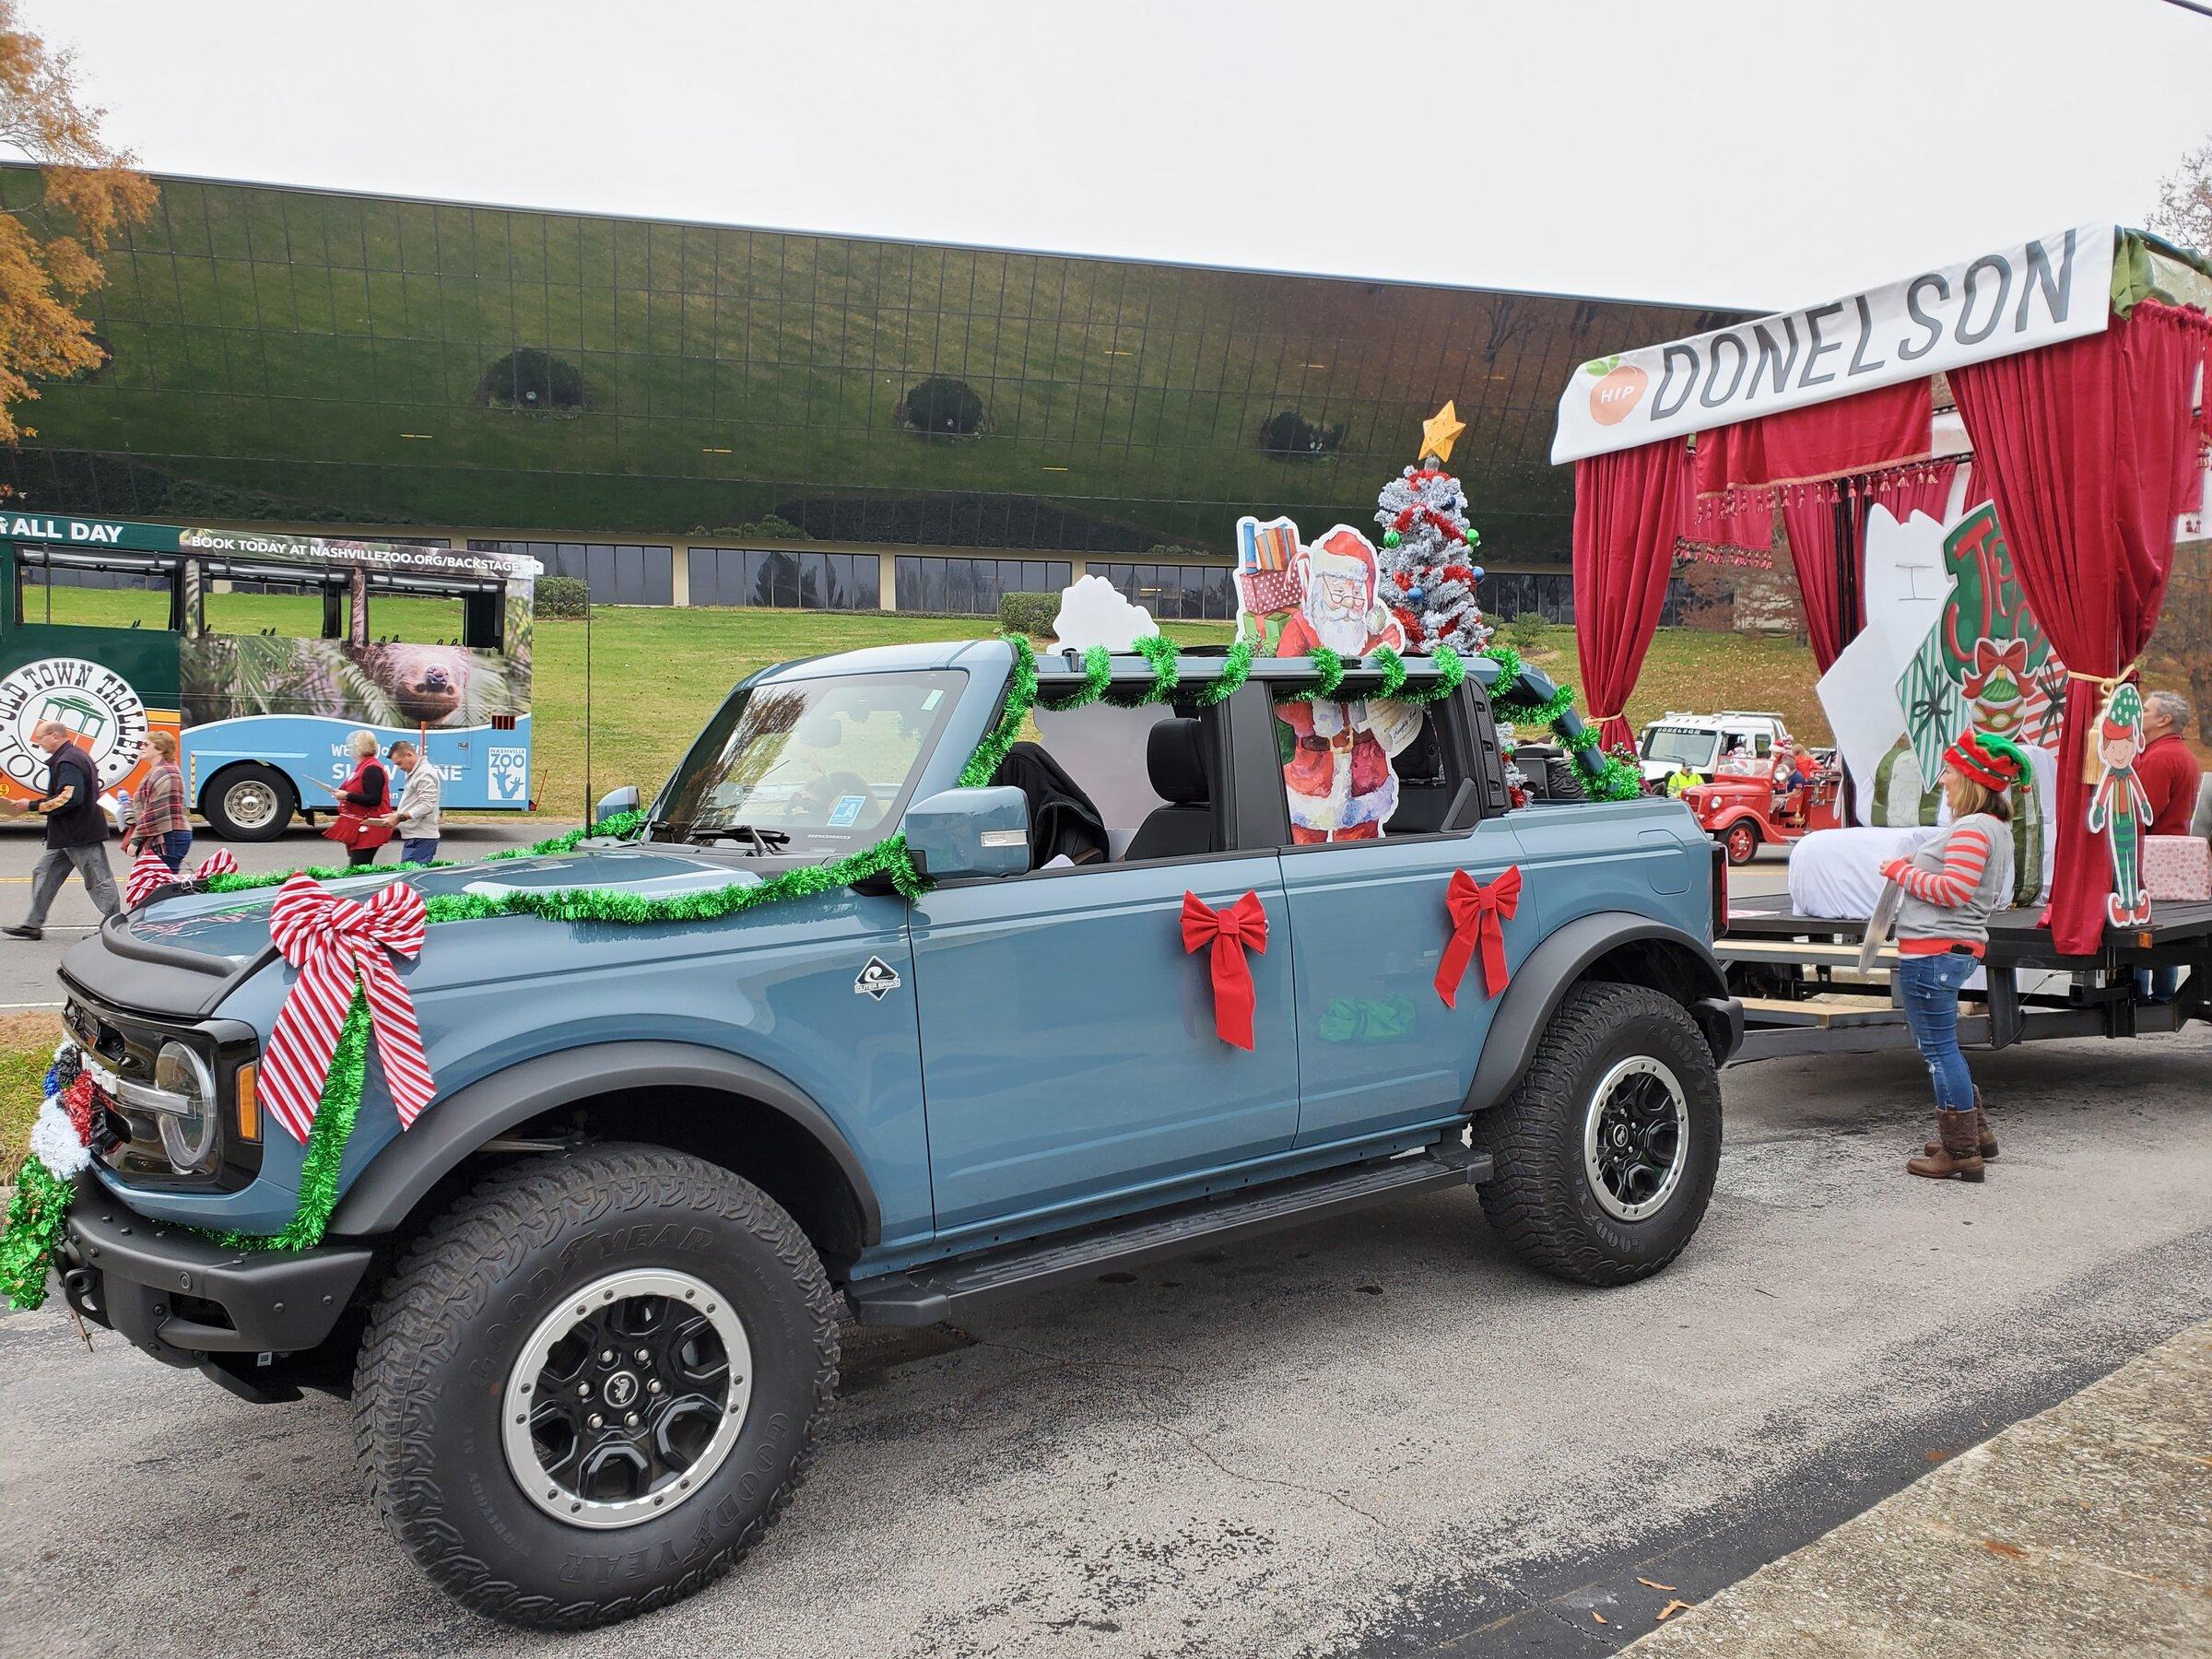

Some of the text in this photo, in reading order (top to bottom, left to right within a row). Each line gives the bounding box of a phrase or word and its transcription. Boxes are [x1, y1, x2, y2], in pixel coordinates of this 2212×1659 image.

[1601, 229, 2077, 421] HIP DONELSON
[11, 518, 63, 538] ALL
[71, 523, 124, 542] DAY
[192, 535, 519, 571] BOOK TODAY AT NASHVILLEZOO.ORG/BACKSTAGE
[0, 662, 146, 765] OLD TOWN TROLLEY
[489, 753, 525, 769] ZOO
